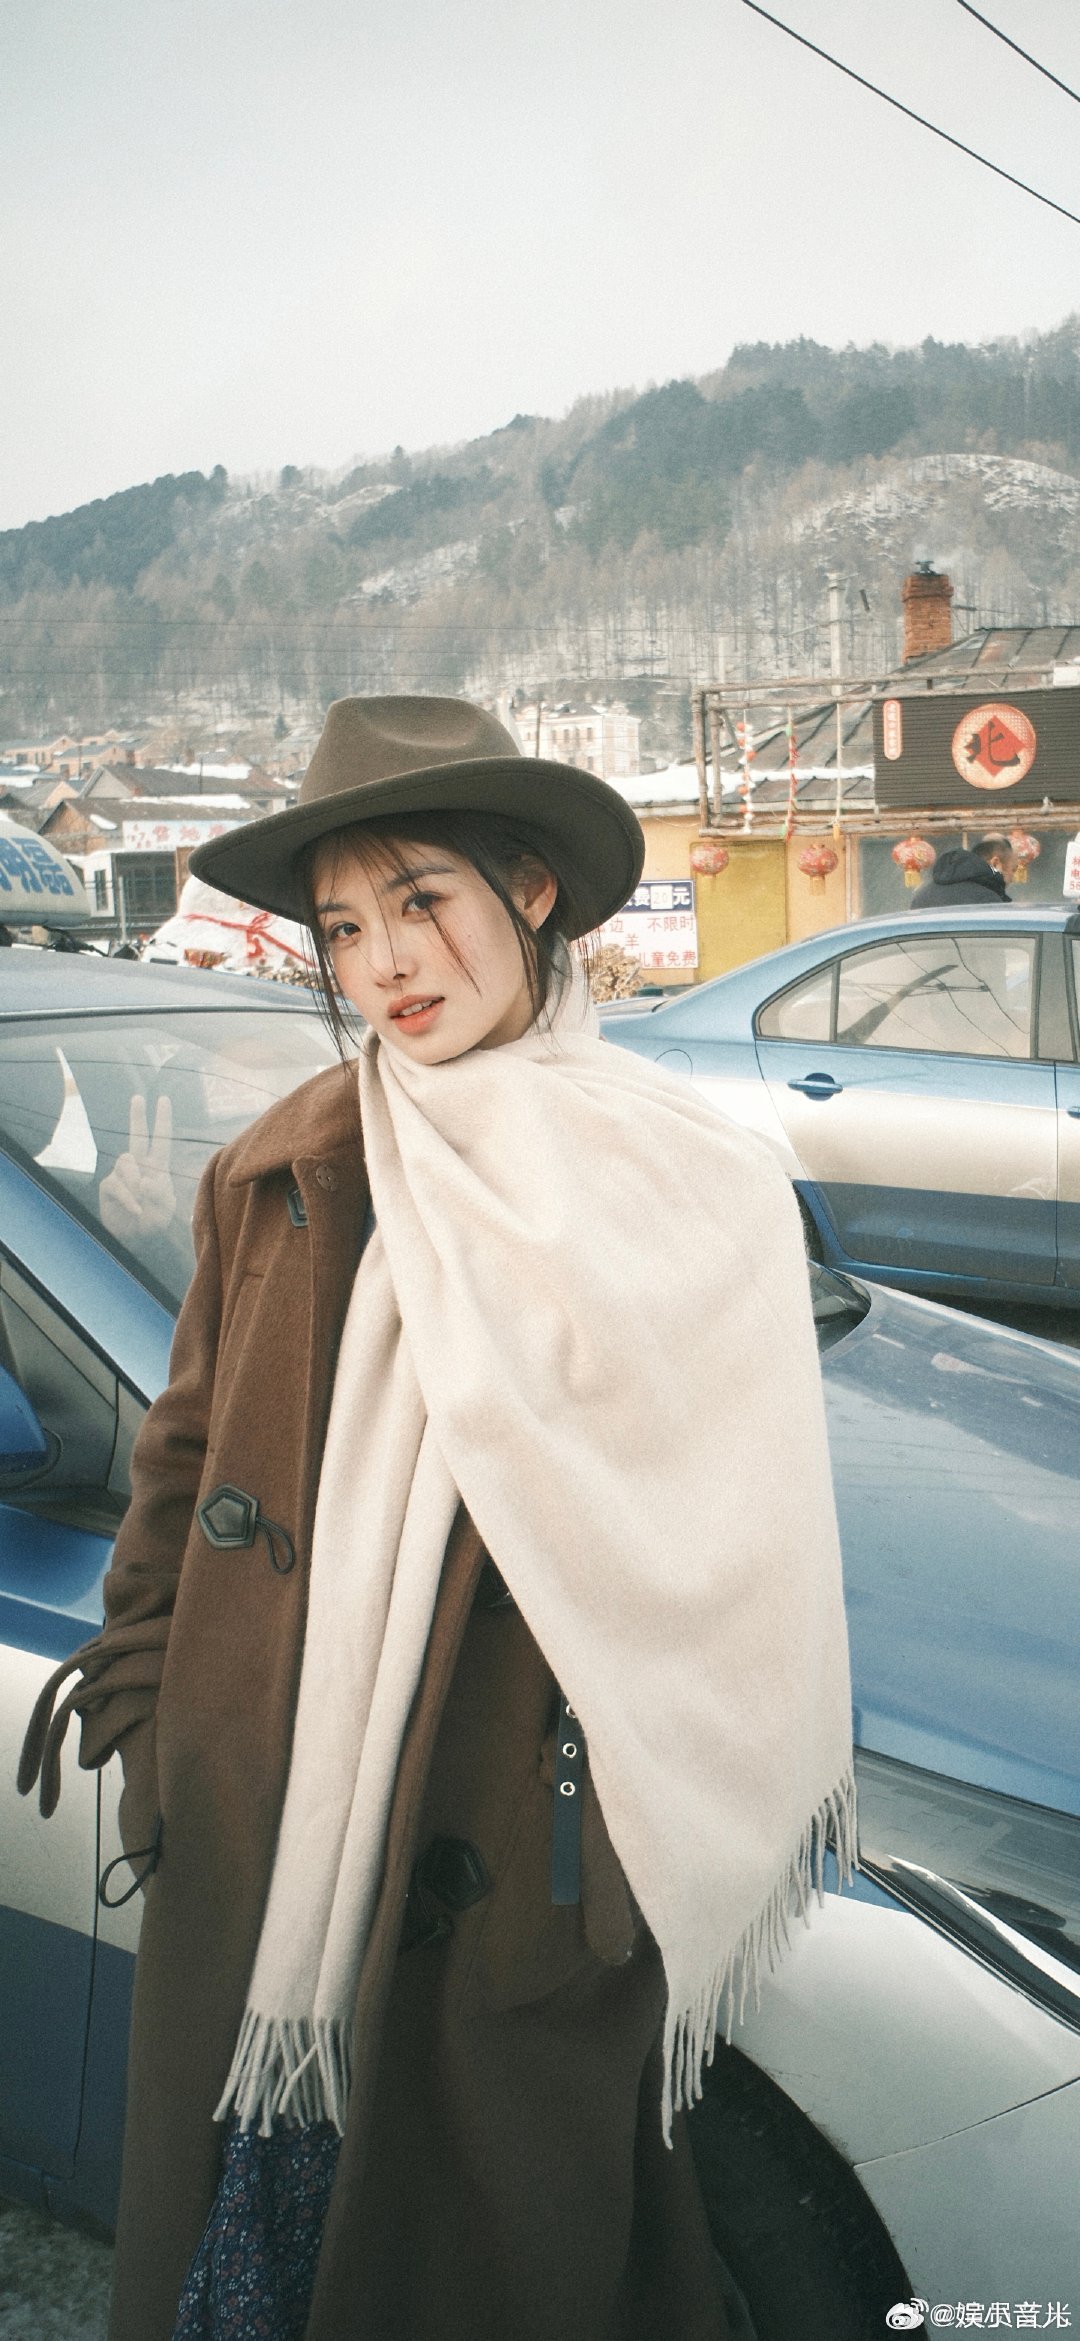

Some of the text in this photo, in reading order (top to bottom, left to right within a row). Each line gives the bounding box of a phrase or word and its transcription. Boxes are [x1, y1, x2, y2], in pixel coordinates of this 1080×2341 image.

[964, 720, 1021, 767] 北
[647, 915, 694, 932] 不限时
[639, 951, 697, 967] 儿童免费
